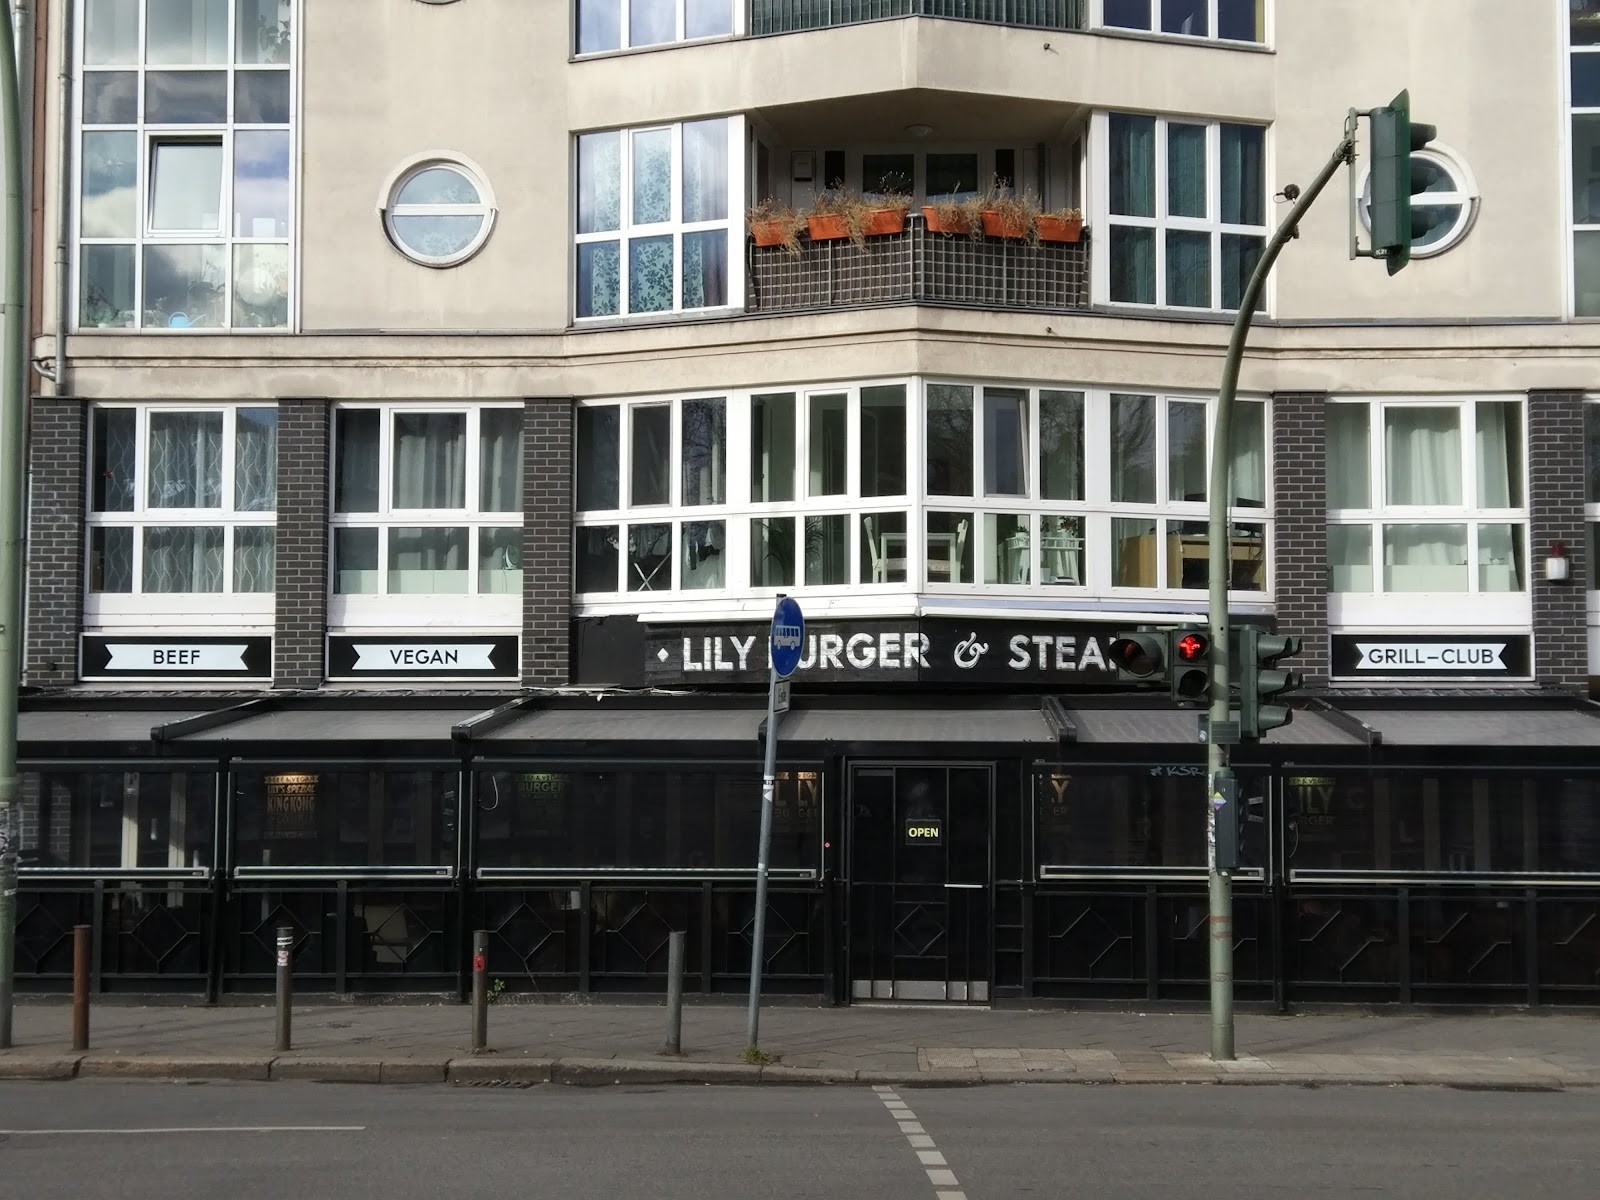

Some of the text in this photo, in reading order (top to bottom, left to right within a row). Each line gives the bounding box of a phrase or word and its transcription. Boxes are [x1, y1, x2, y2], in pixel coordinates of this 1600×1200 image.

[153, 649, 201, 665] BEEF
[390, 649, 458, 665] VEGAN
[683, 631, 1118, 671] LILY URGER & STEA
[1368, 648, 1494, 664] GRILL-CLUB
[908, 828, 939, 838] OPEN
